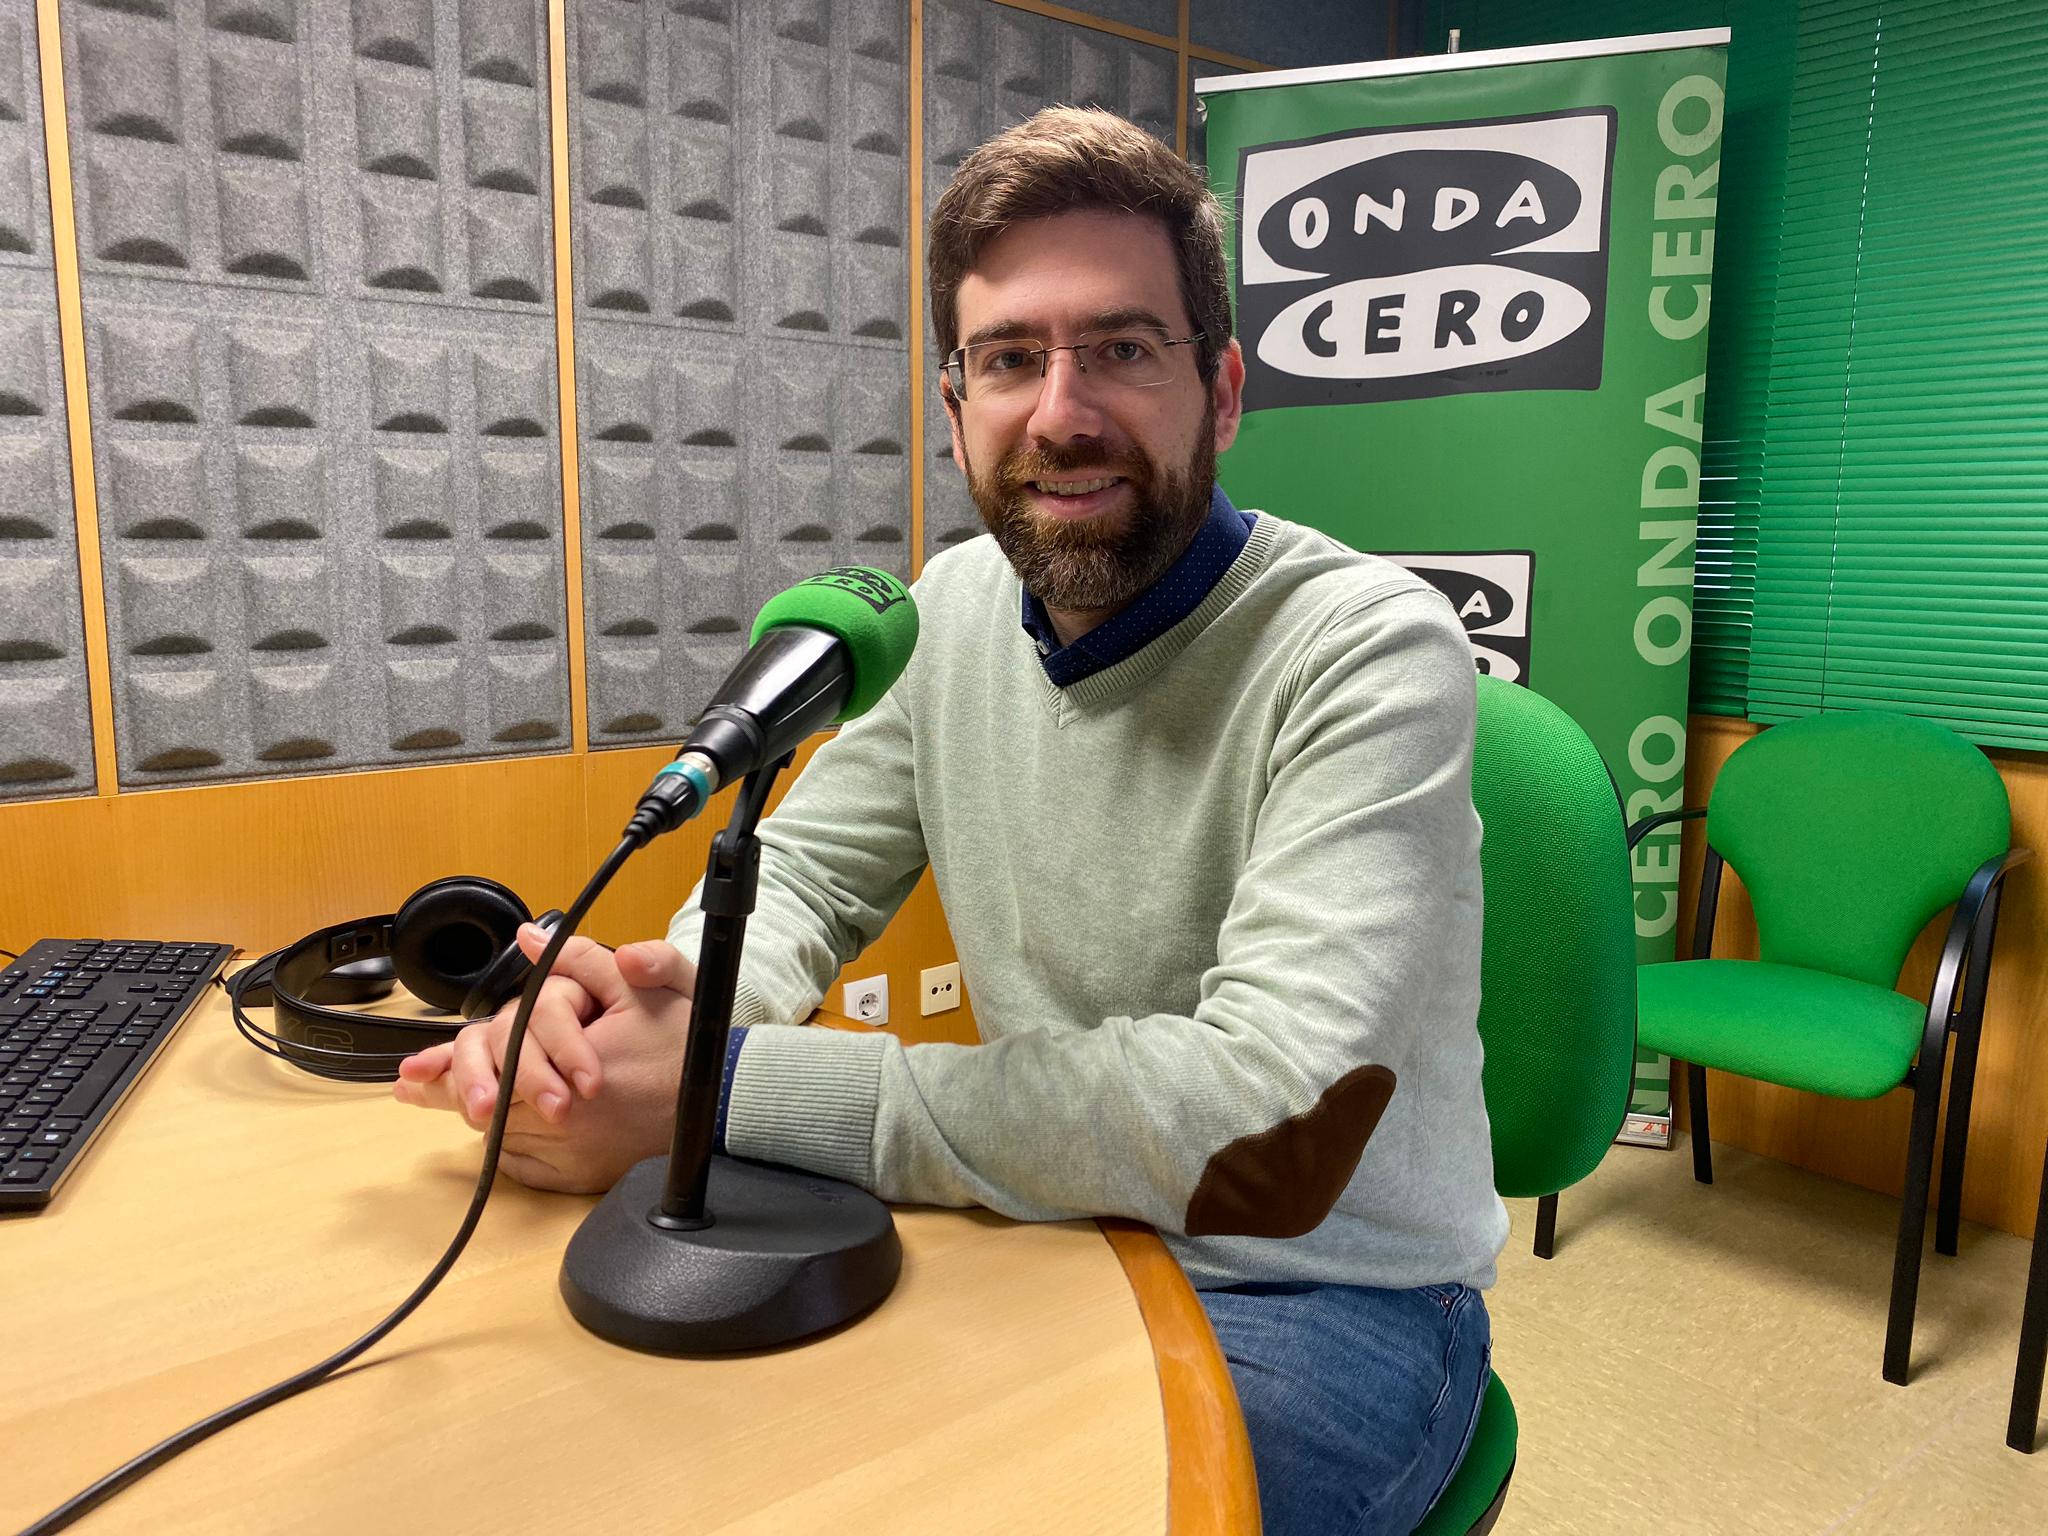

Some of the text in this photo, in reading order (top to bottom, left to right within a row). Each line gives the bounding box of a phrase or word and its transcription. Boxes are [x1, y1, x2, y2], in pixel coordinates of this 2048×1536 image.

[1289, 180, 1546, 249] ONDA
[1648, 75, 1725, 340] CERO
[1302, 290, 1544, 358] CERO
[1634, 373, 1706, 666] ONDA
